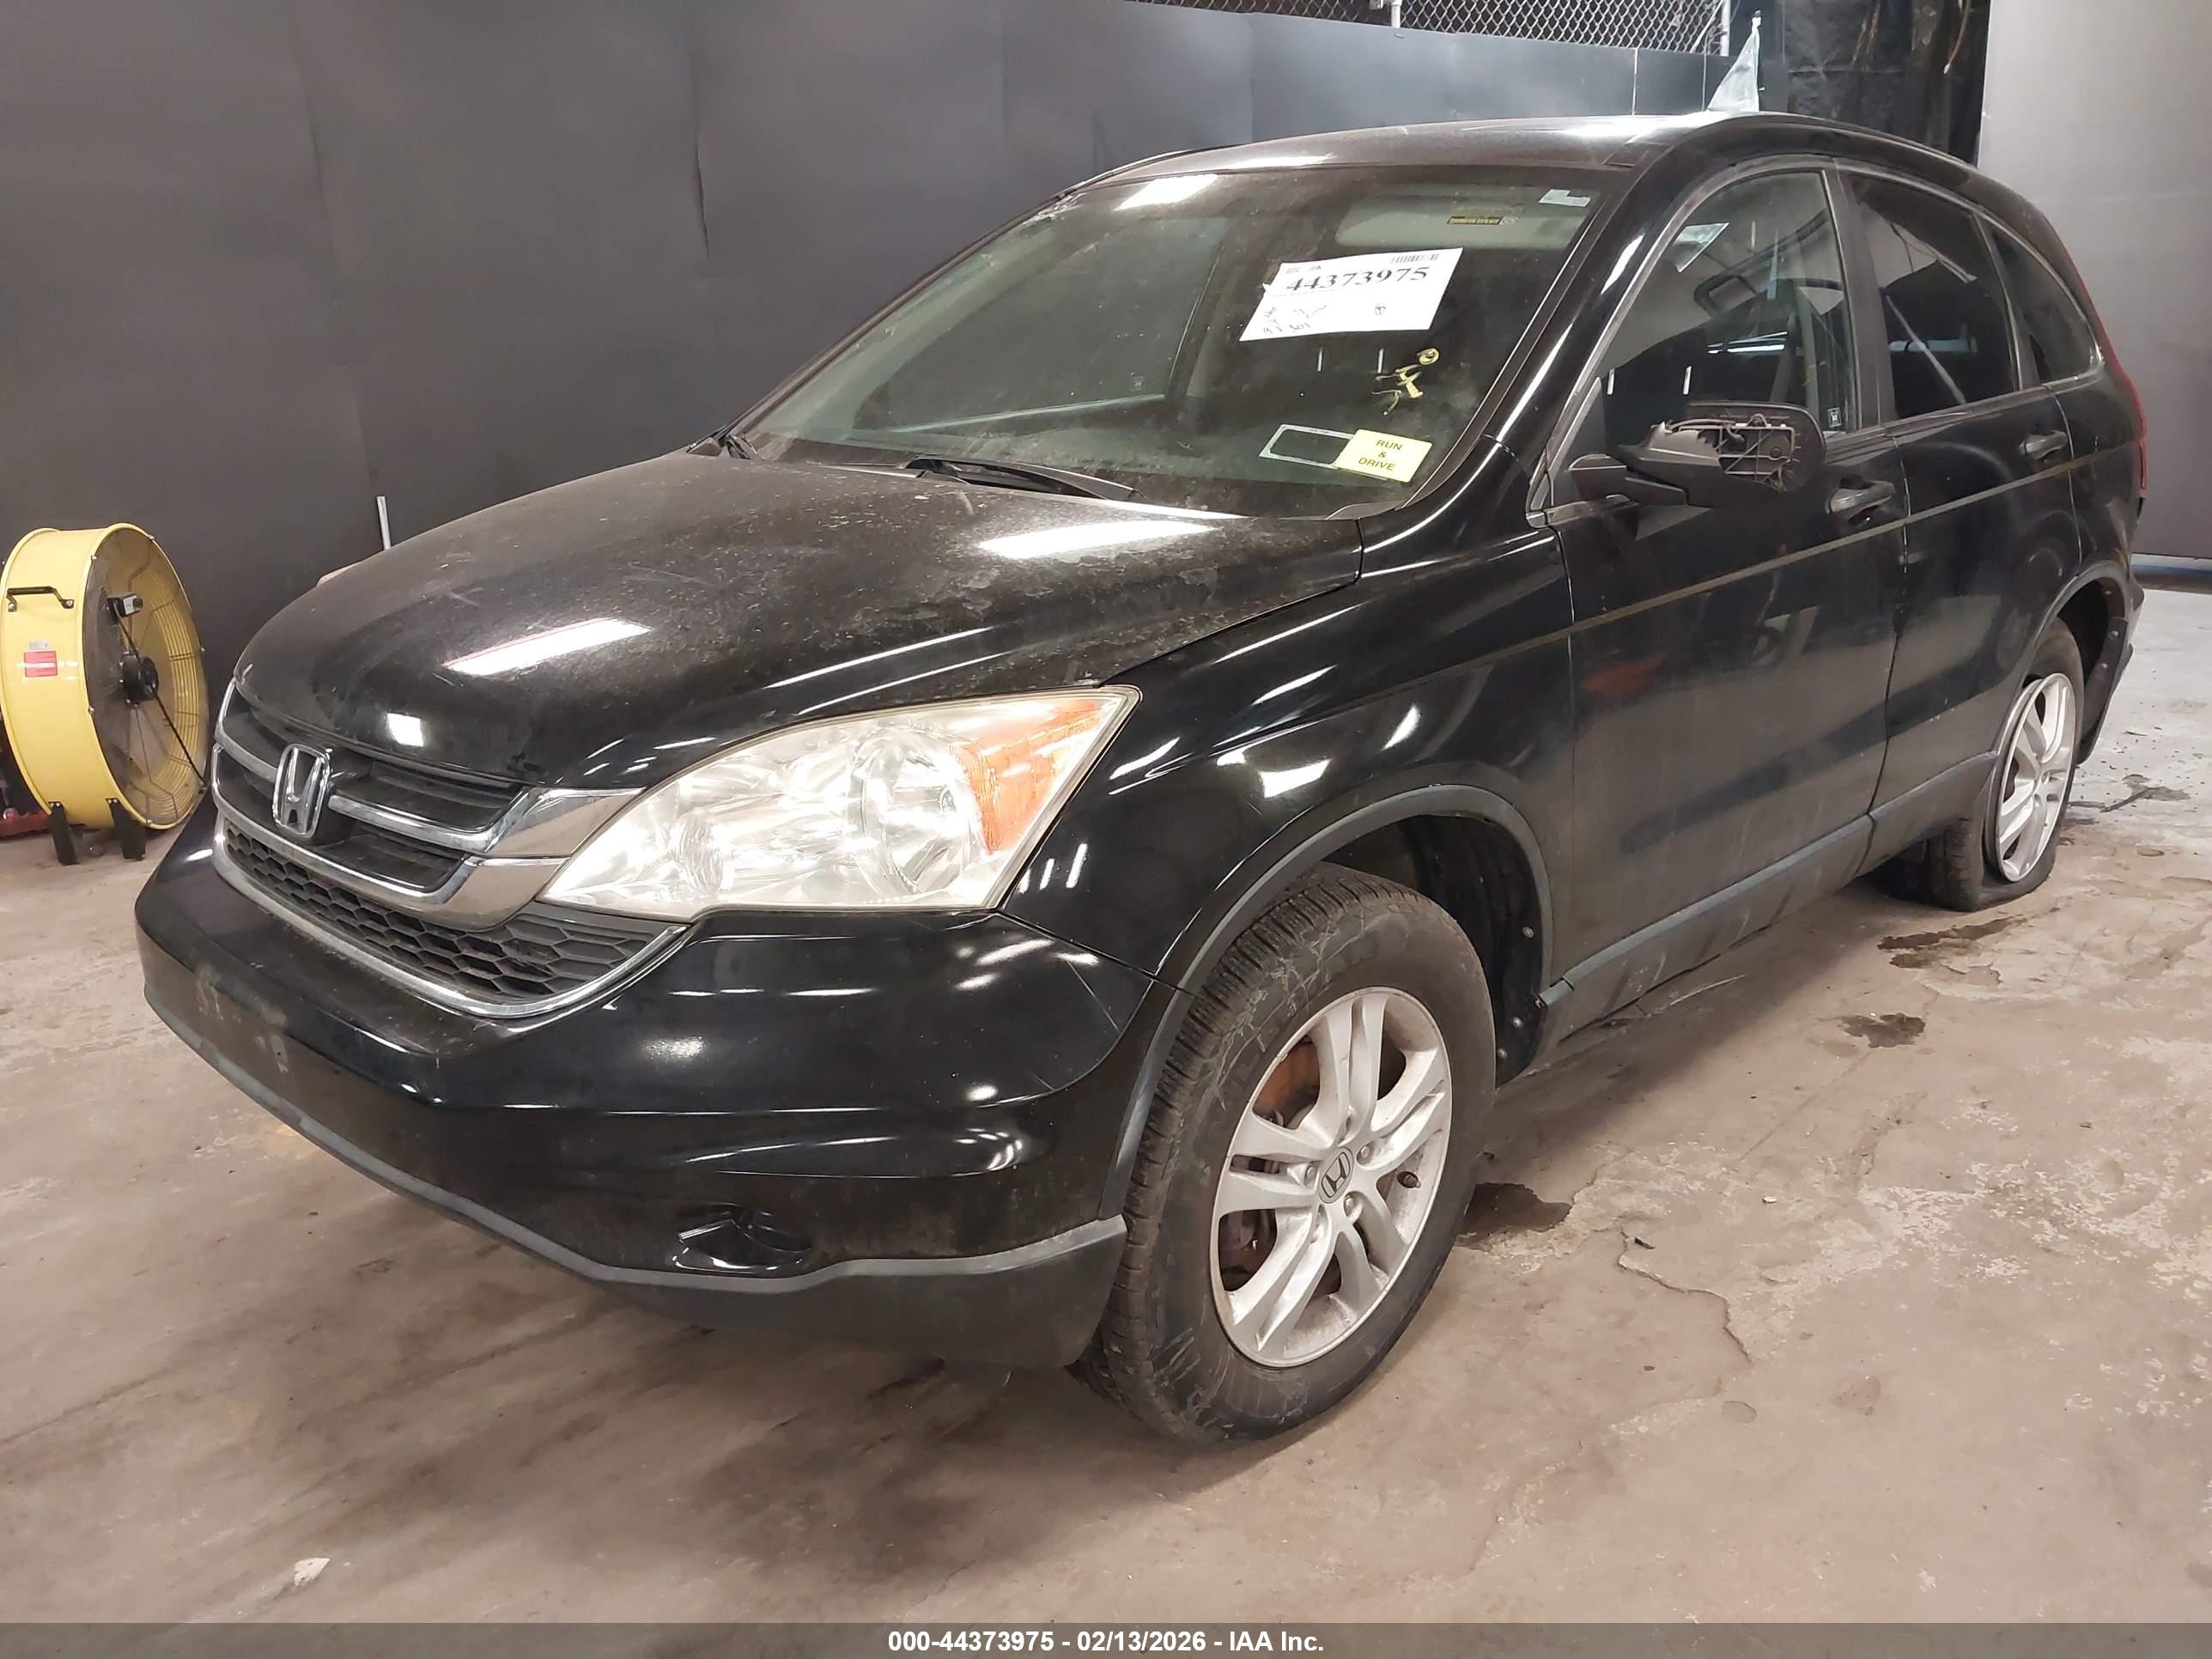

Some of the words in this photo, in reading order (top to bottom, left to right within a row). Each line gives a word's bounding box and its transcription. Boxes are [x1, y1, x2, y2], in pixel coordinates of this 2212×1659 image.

[1287, 266, 1429, 290] 44373975
[1376, 440, 1403, 451] RUN
[1358, 457, 1396, 471] DRIVE
